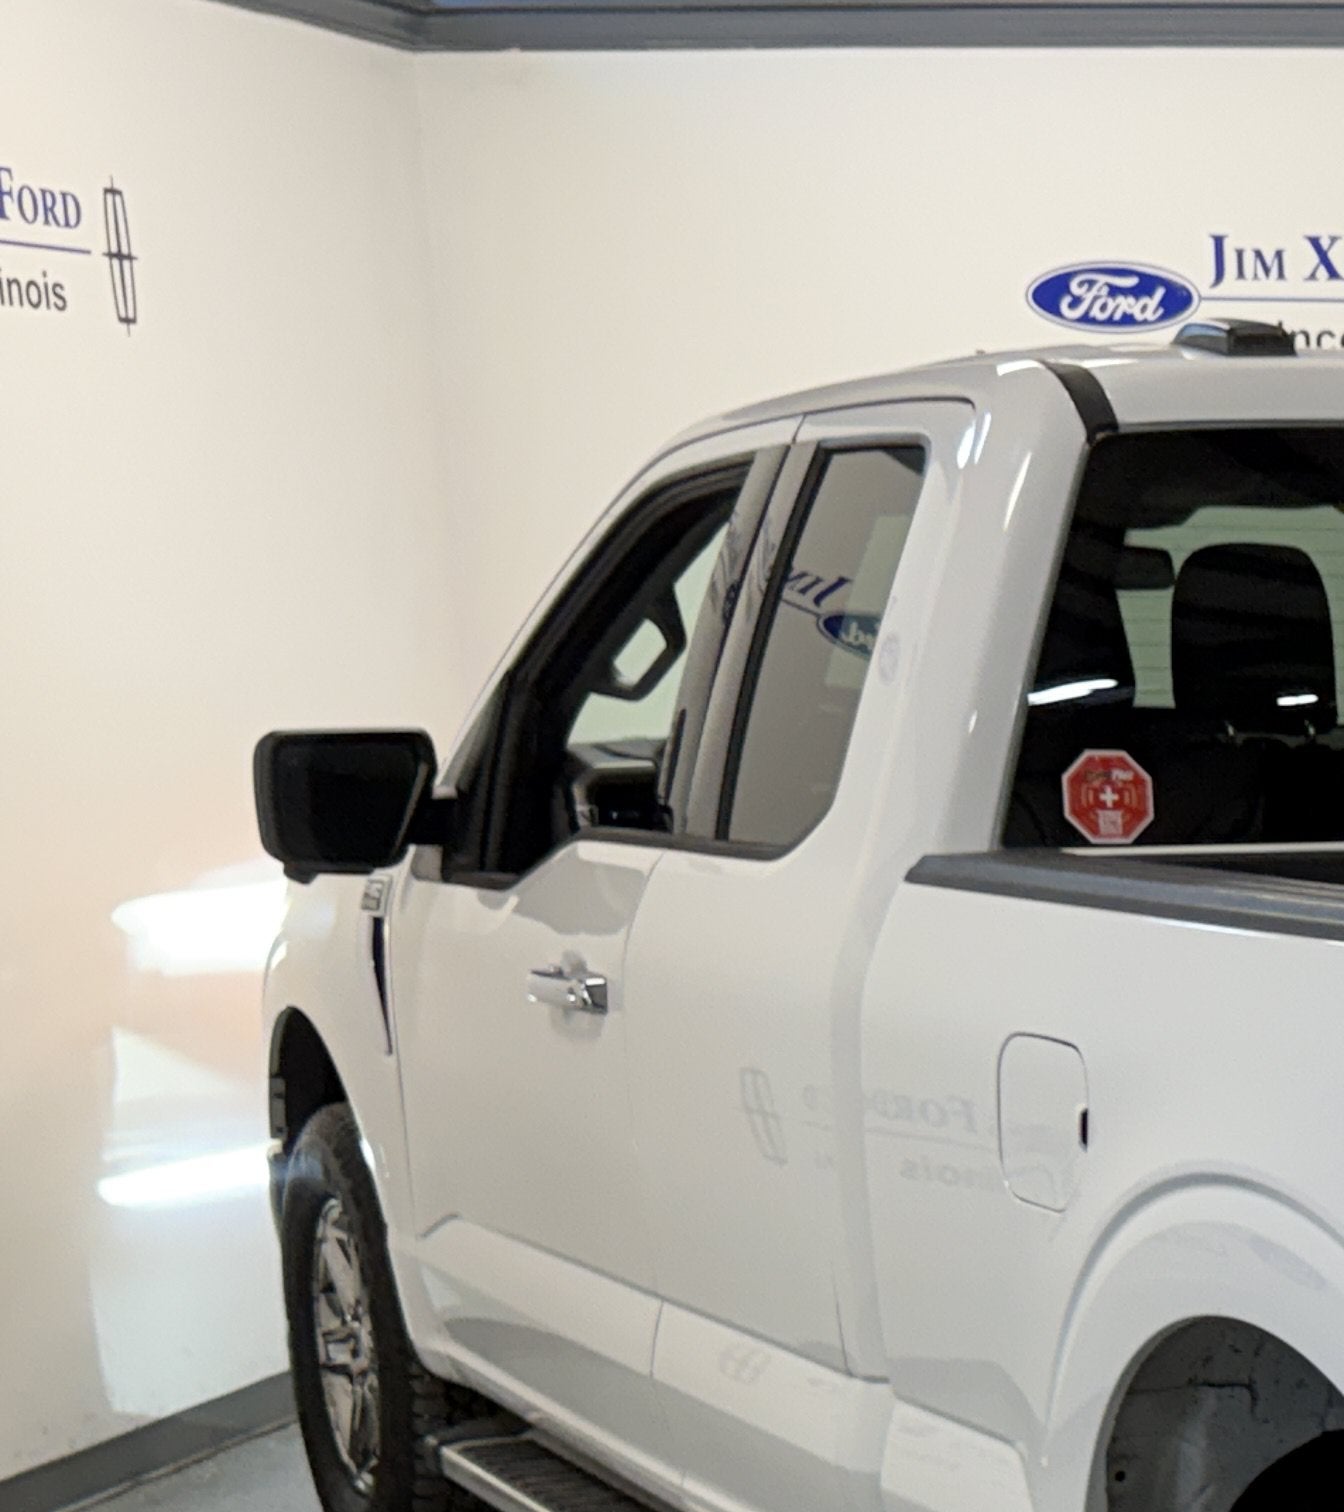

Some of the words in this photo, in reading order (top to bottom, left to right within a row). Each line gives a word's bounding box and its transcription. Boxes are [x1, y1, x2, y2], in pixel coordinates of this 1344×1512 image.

[1209, 233, 1288, 288] JIM
[0, 268, 67, 312] inois
[1058, 270, 1165, 324] Ford
